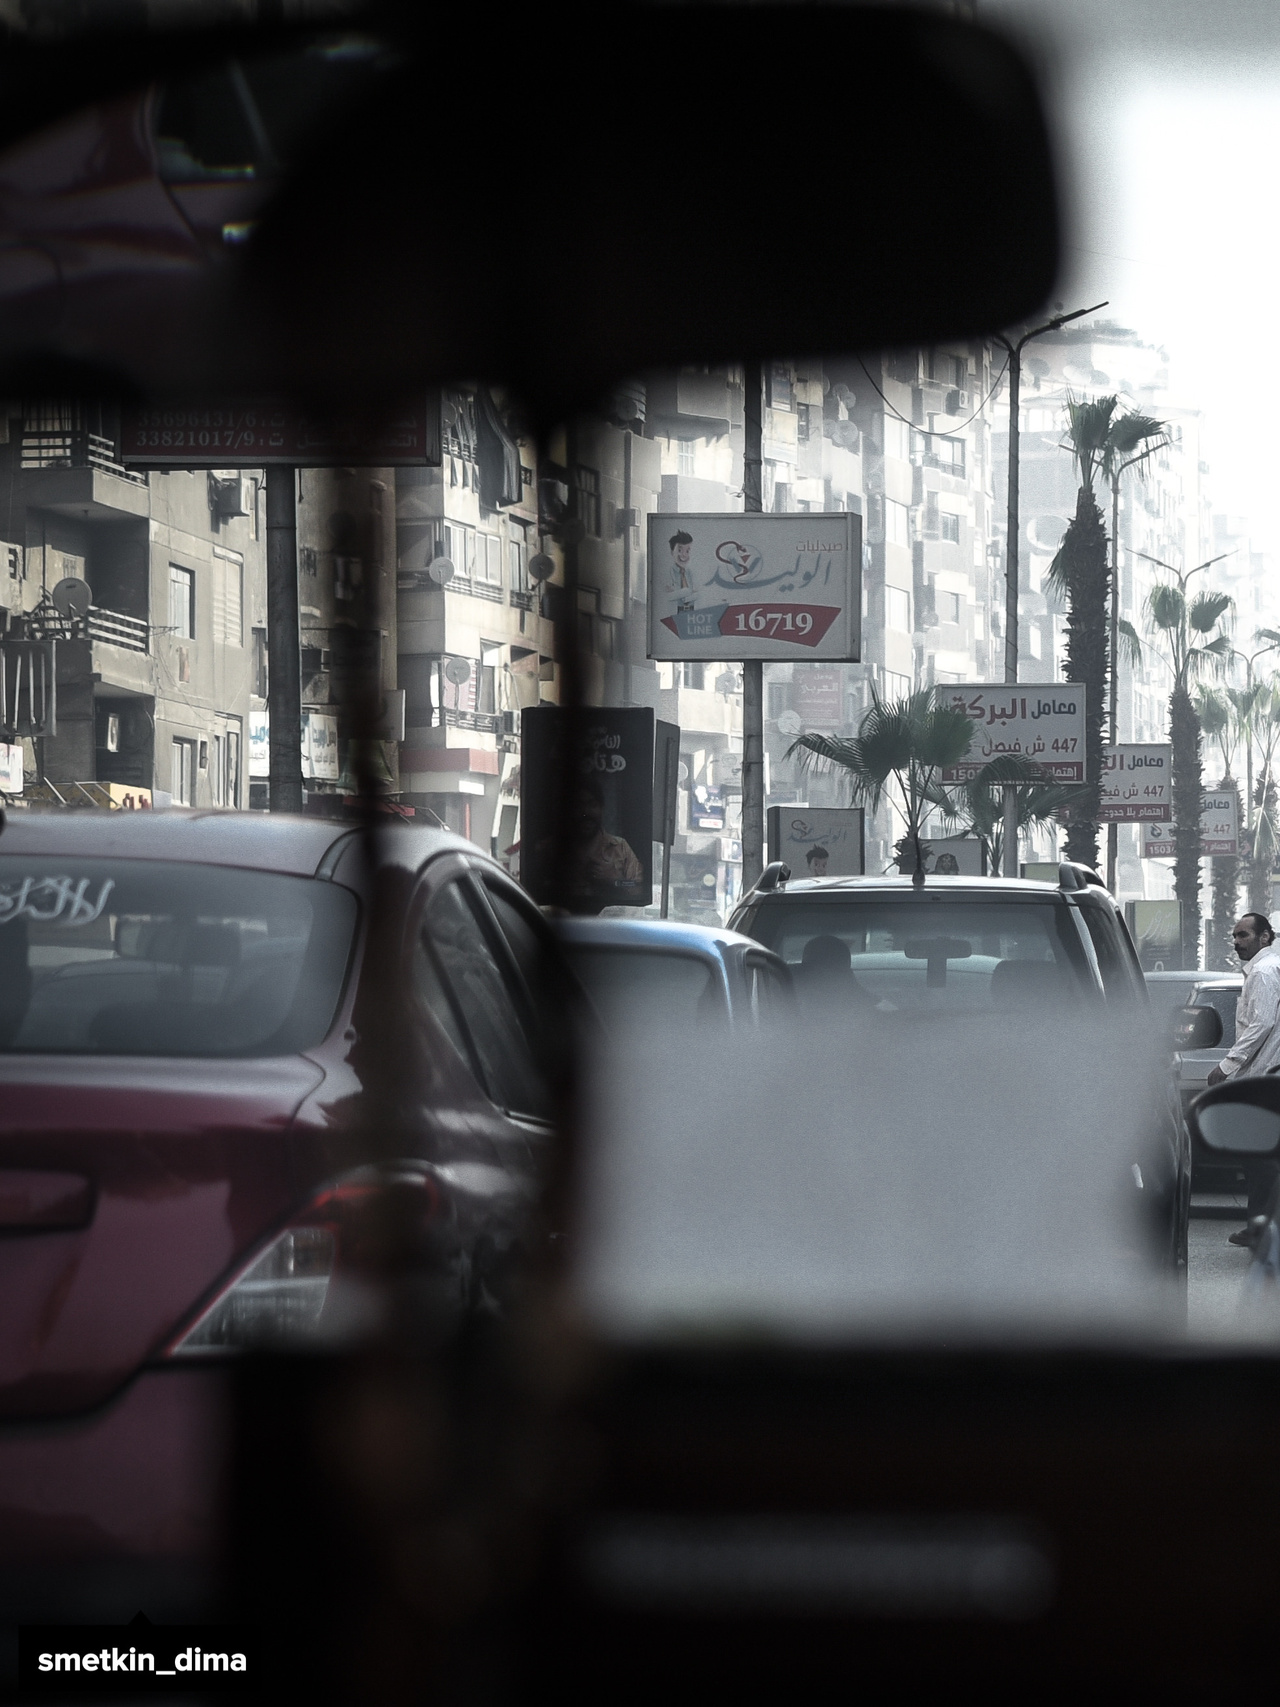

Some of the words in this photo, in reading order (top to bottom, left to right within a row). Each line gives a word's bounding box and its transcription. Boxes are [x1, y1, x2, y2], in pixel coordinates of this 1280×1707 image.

[136, 430, 255, 450] 33821017/9
[796, 539, 843, 552] صيدليات
[705, 552, 832, 593] الوليد
[687, 613, 713, 624] HOT
[735, 608, 813, 636] 16719
[687, 624, 712, 636] LINE
[951, 695, 1027, 726] البركة
[1031, 699, 1077, 720] معامل
[1026, 735, 1045, 756] ش
[1051, 738, 1078, 753] 447
[1127, 755, 1164, 770] معامل
[1123, 783, 1139, 800] ش
[1143, 785, 1165, 797] 447
[1126, 807, 1136, 819] بلا
[1213, 824, 1231, 834] 447
